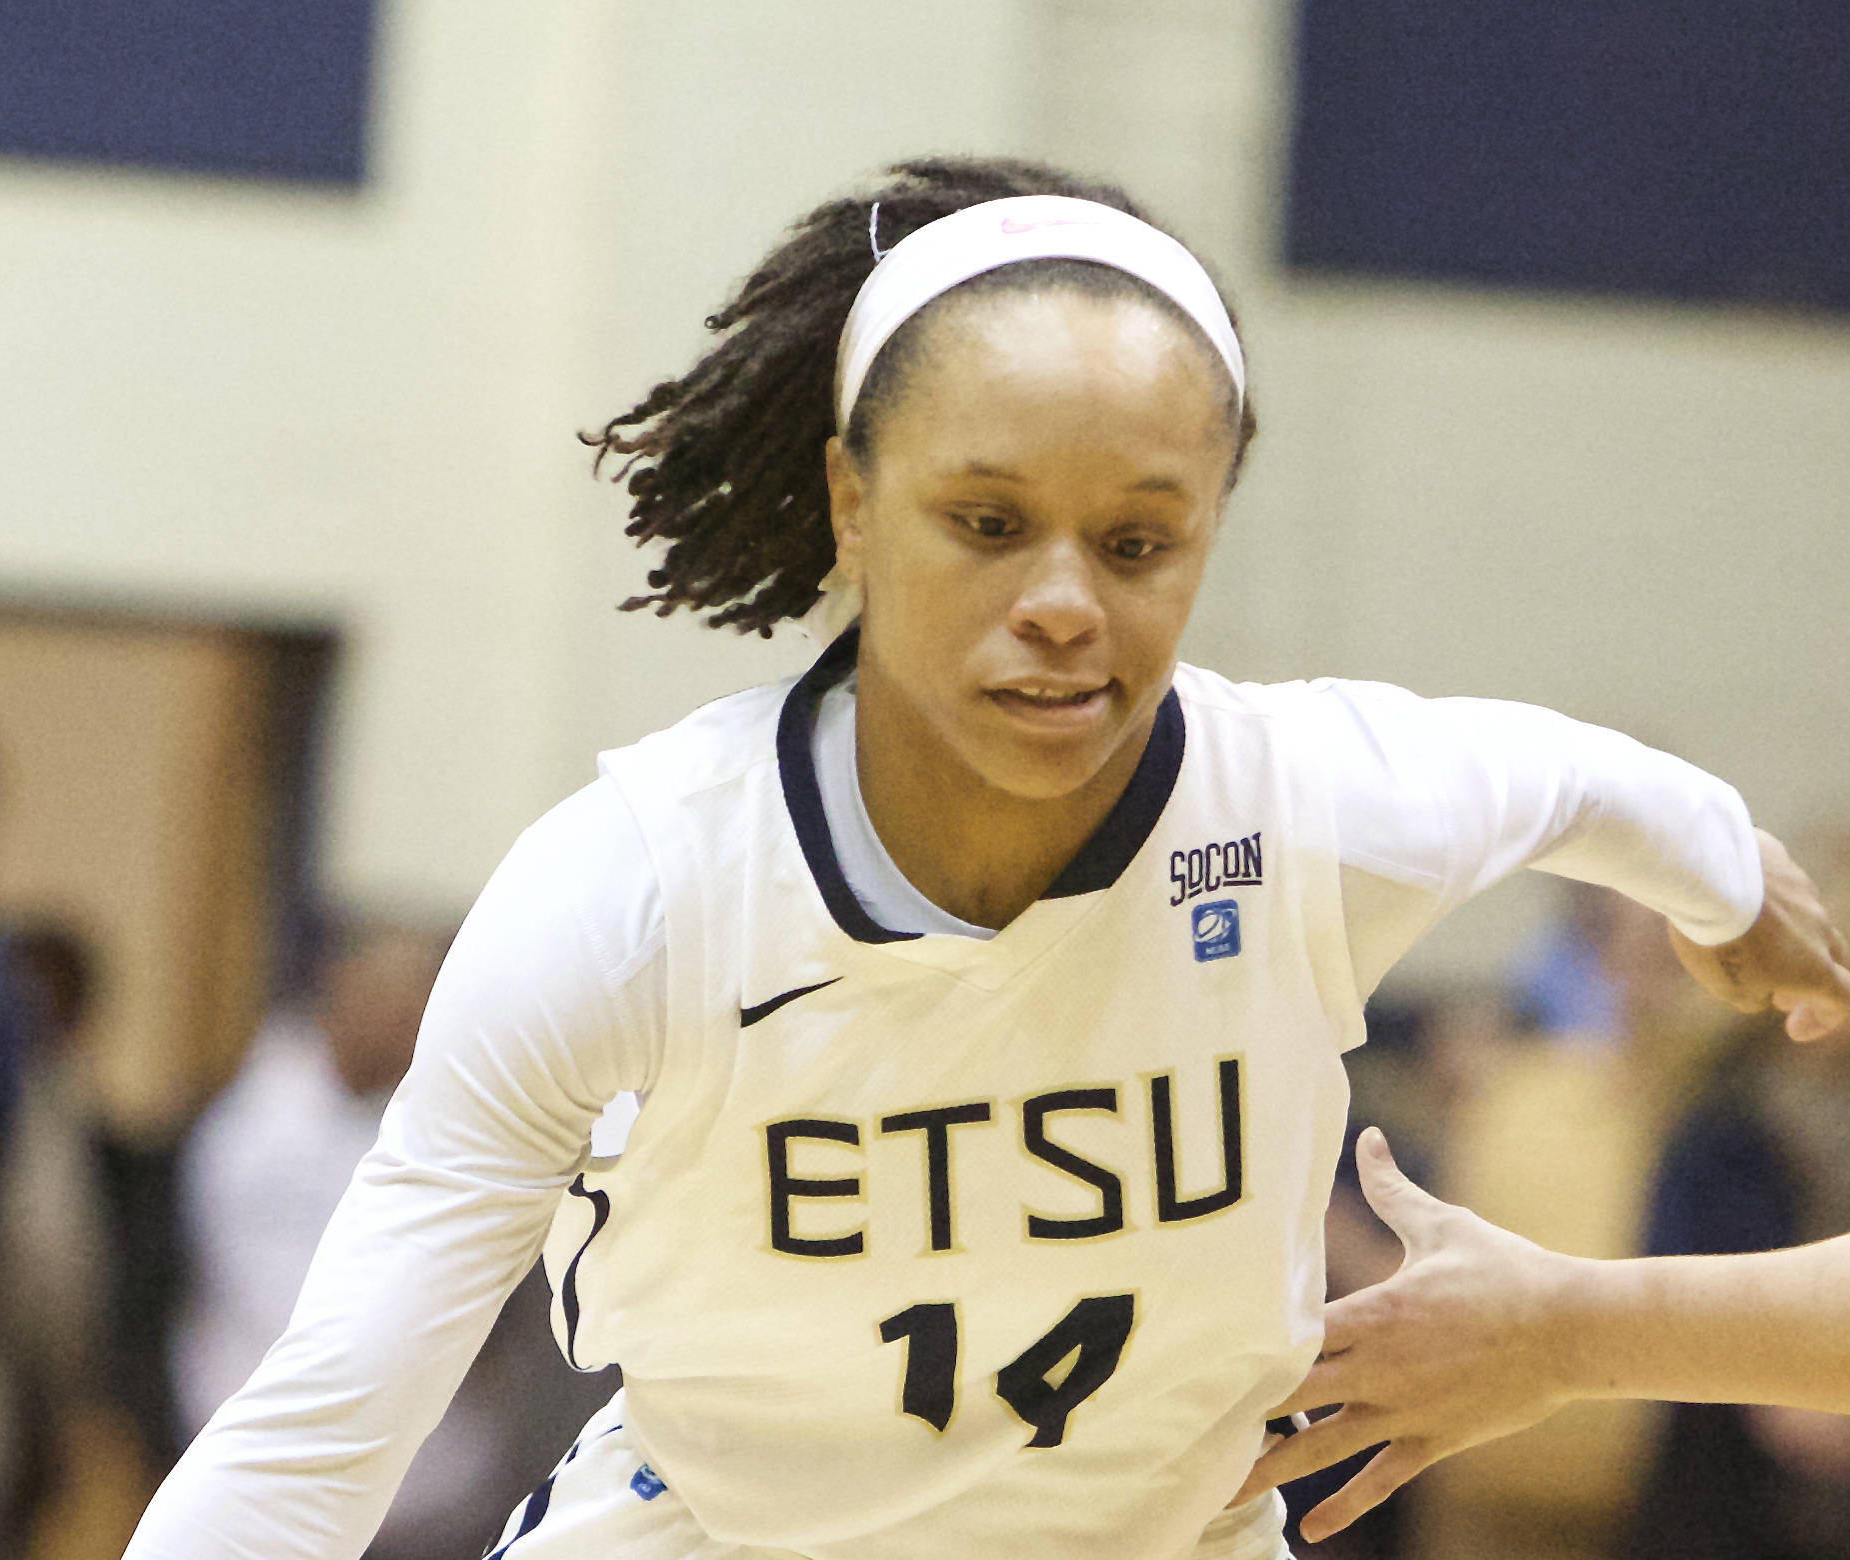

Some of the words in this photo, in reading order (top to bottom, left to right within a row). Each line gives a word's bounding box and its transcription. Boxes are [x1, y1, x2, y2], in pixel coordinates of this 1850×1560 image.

[1169, 831, 1263, 908] SOCON
[760, 1052, 1247, 1260] ETSU
[877, 1288, 1141, 1450] 14
